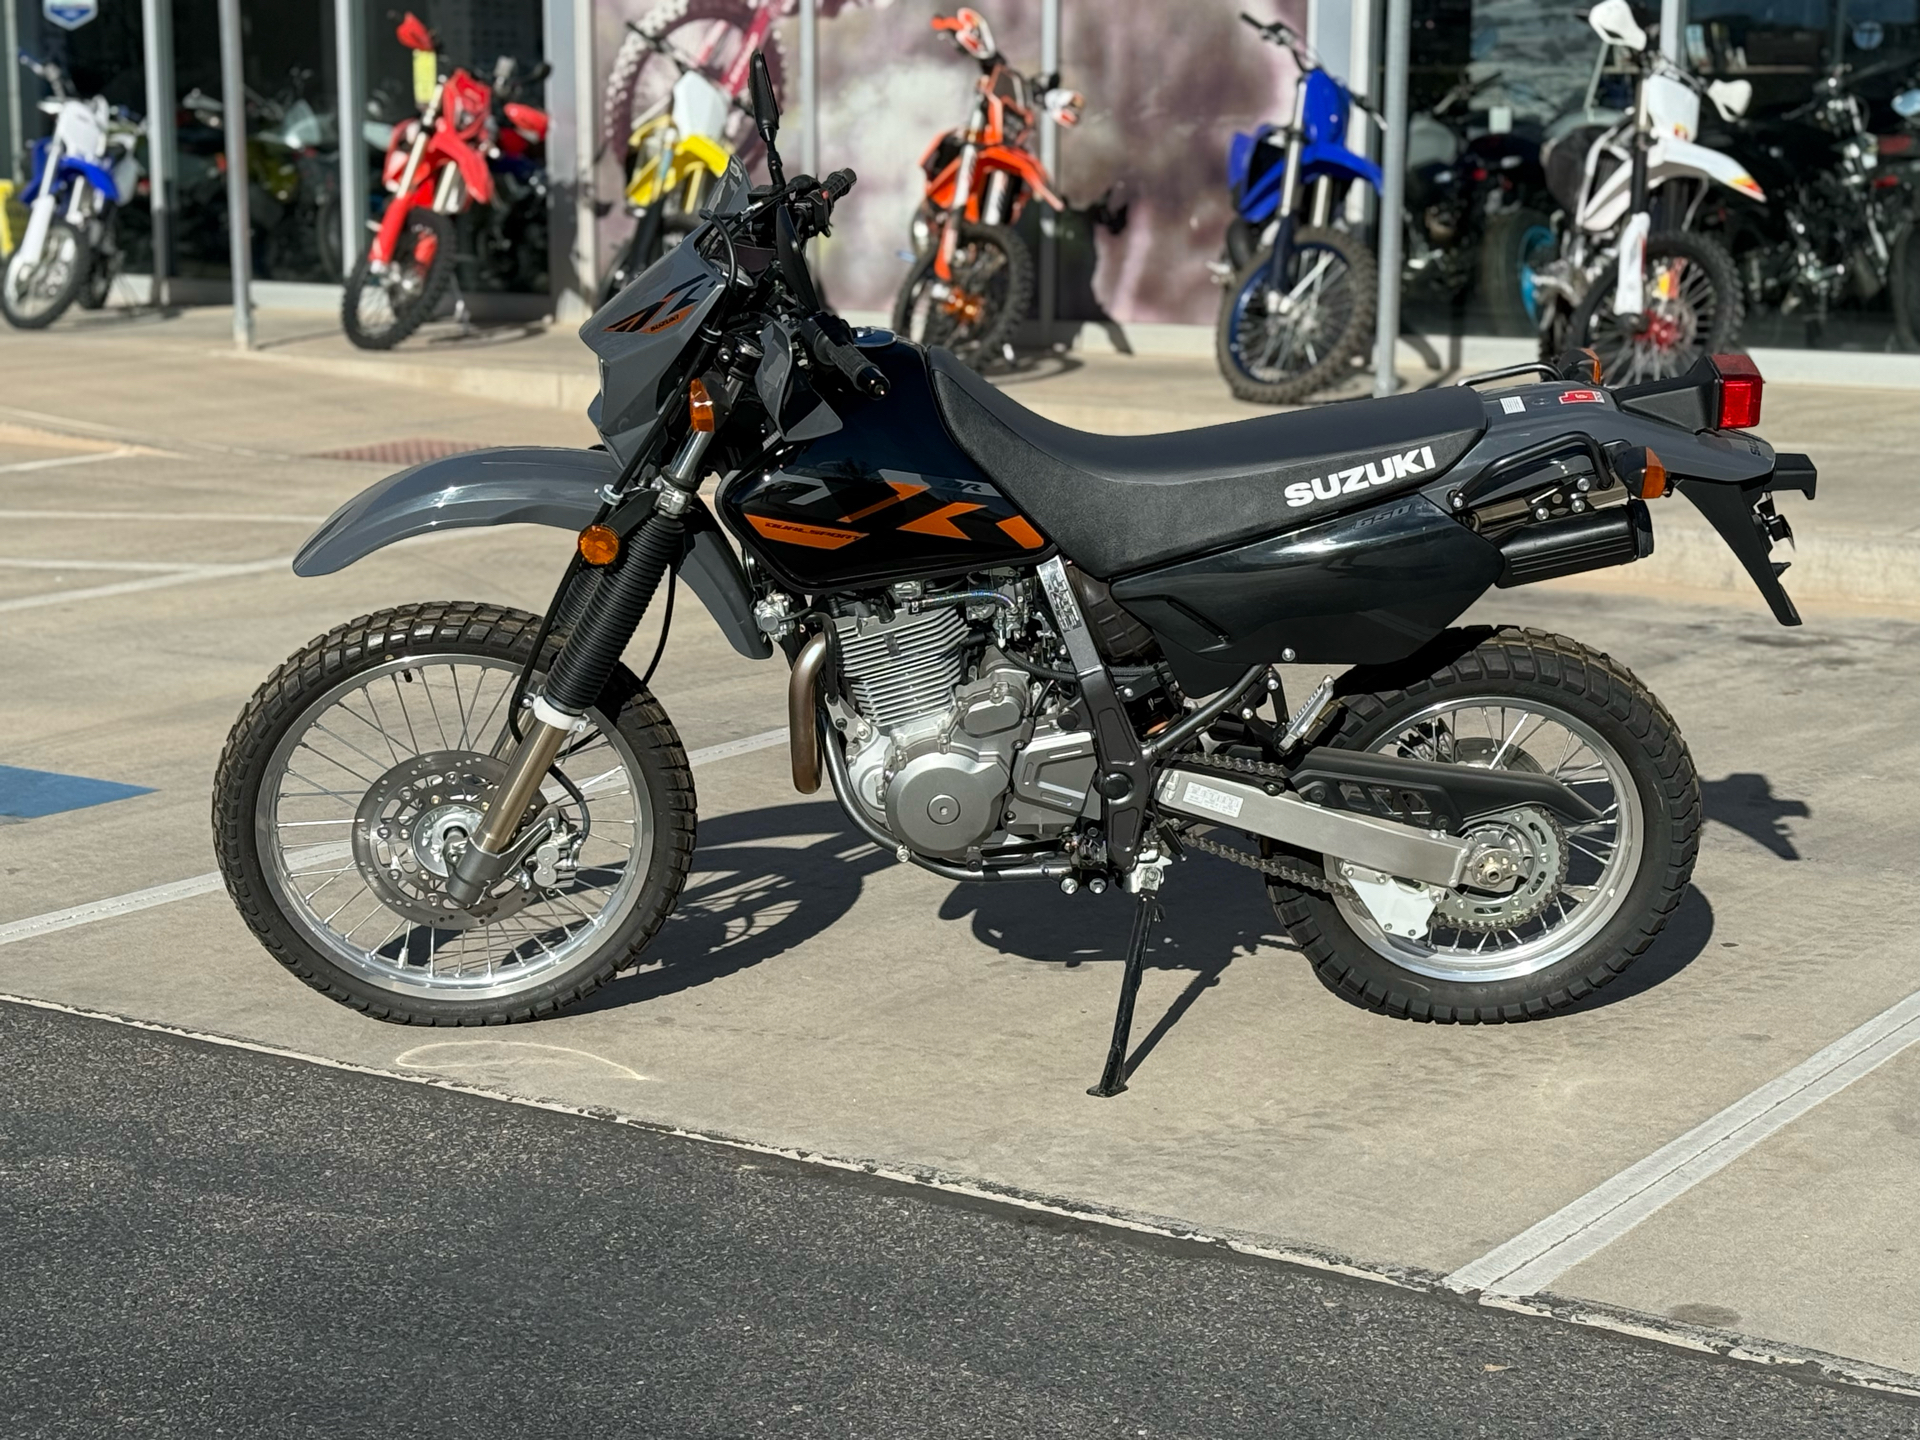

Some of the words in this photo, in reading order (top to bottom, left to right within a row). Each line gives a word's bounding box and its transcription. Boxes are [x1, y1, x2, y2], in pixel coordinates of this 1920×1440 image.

[651, 314, 680, 331] SUZUKI
[1284, 445, 1436, 507] SUZUKI
[1354, 504, 1411, 530] 650
